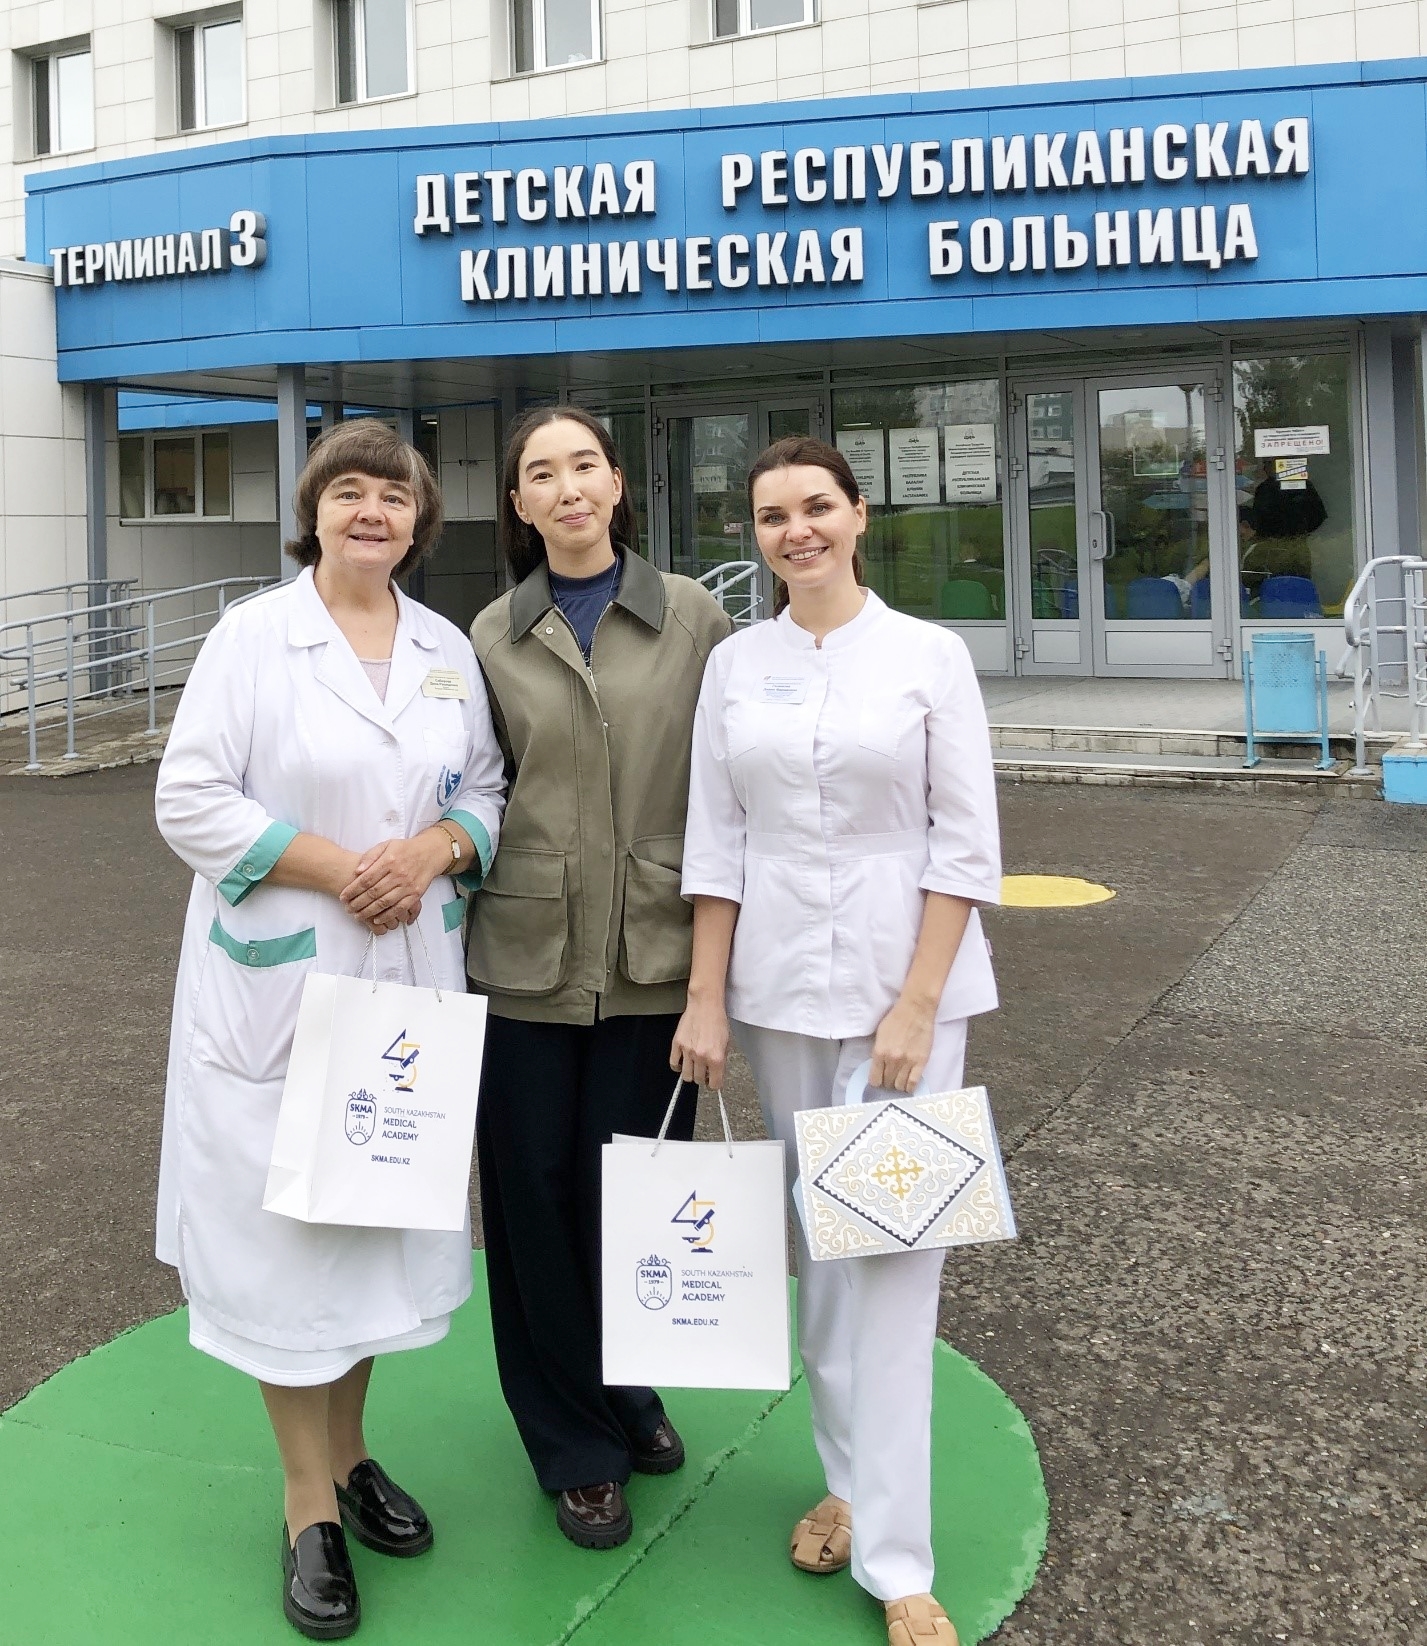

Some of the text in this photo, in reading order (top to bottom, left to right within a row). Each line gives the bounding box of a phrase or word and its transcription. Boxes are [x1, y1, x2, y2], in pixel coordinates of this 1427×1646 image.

[413, 116, 1310, 235] ДЕТСКАЯ РЕСПУБЛИКАНСКАЯ
[49, 210, 263, 287] ТЕРМИНАЛ 3
[460, 203, 1260, 302] КЛИНИЧЕСКАЯ БОЛЬНИЦА
[349, 1103, 373, 1114] SKMA
[383, 1106, 446, 1120] SOUTH KAZAKHSTAN
[383, 1117, 417, 1129] MEDICAL
[381, 1130, 419, 1141] ACADEMY
[370, 1154, 411, 1165] SKMA.EDU.KZ
[640, 1269, 668, 1279] SKMA
[681, 1269, 754, 1278] SOUTH KAZAKHSTAN
[681, 1280, 722, 1289] MEDICAL
[681, 1293, 726, 1302] ACADEMY
[671, 1317, 720, 1327] SKMA.EDU.KZ
